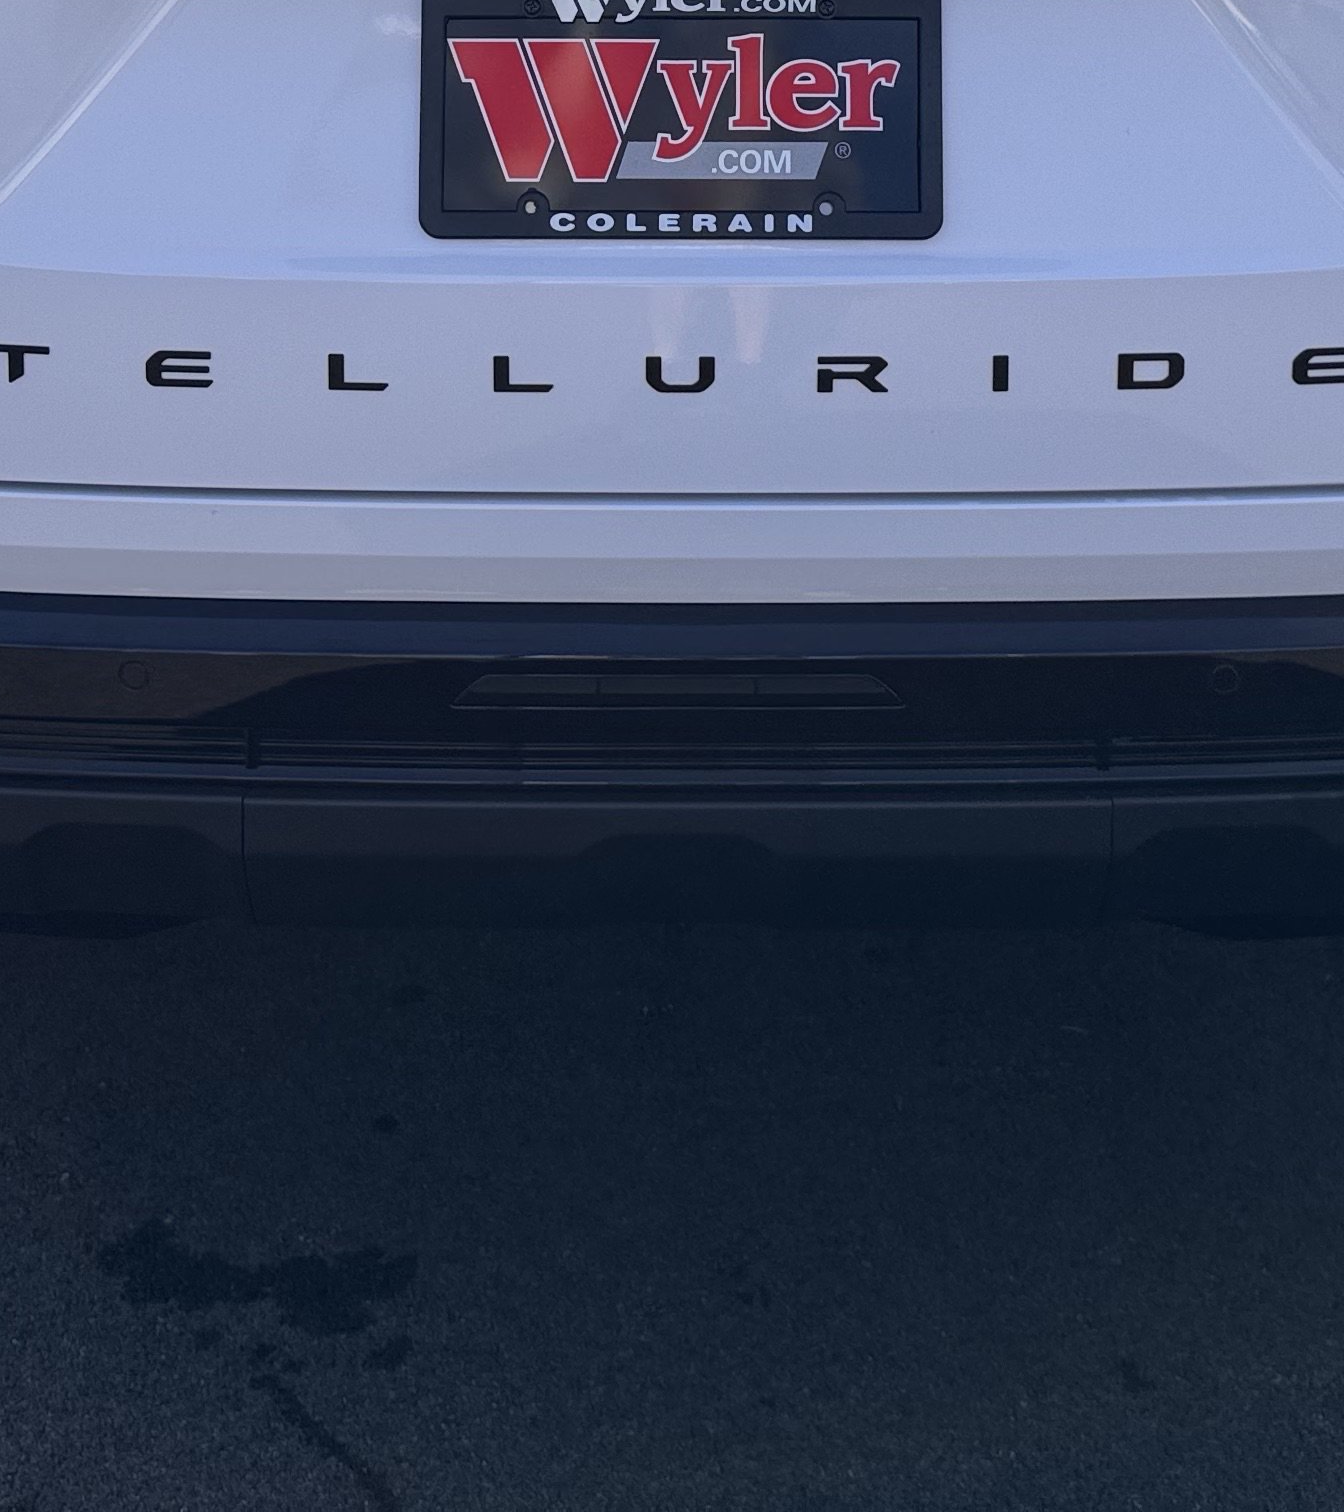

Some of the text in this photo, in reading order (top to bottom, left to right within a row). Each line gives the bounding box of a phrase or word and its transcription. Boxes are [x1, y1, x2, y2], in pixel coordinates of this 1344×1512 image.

[447, 33, 901, 183] Wyler
[711, 149, 792, 174] .COM
[549, 212, 813, 233] COLERAIN
